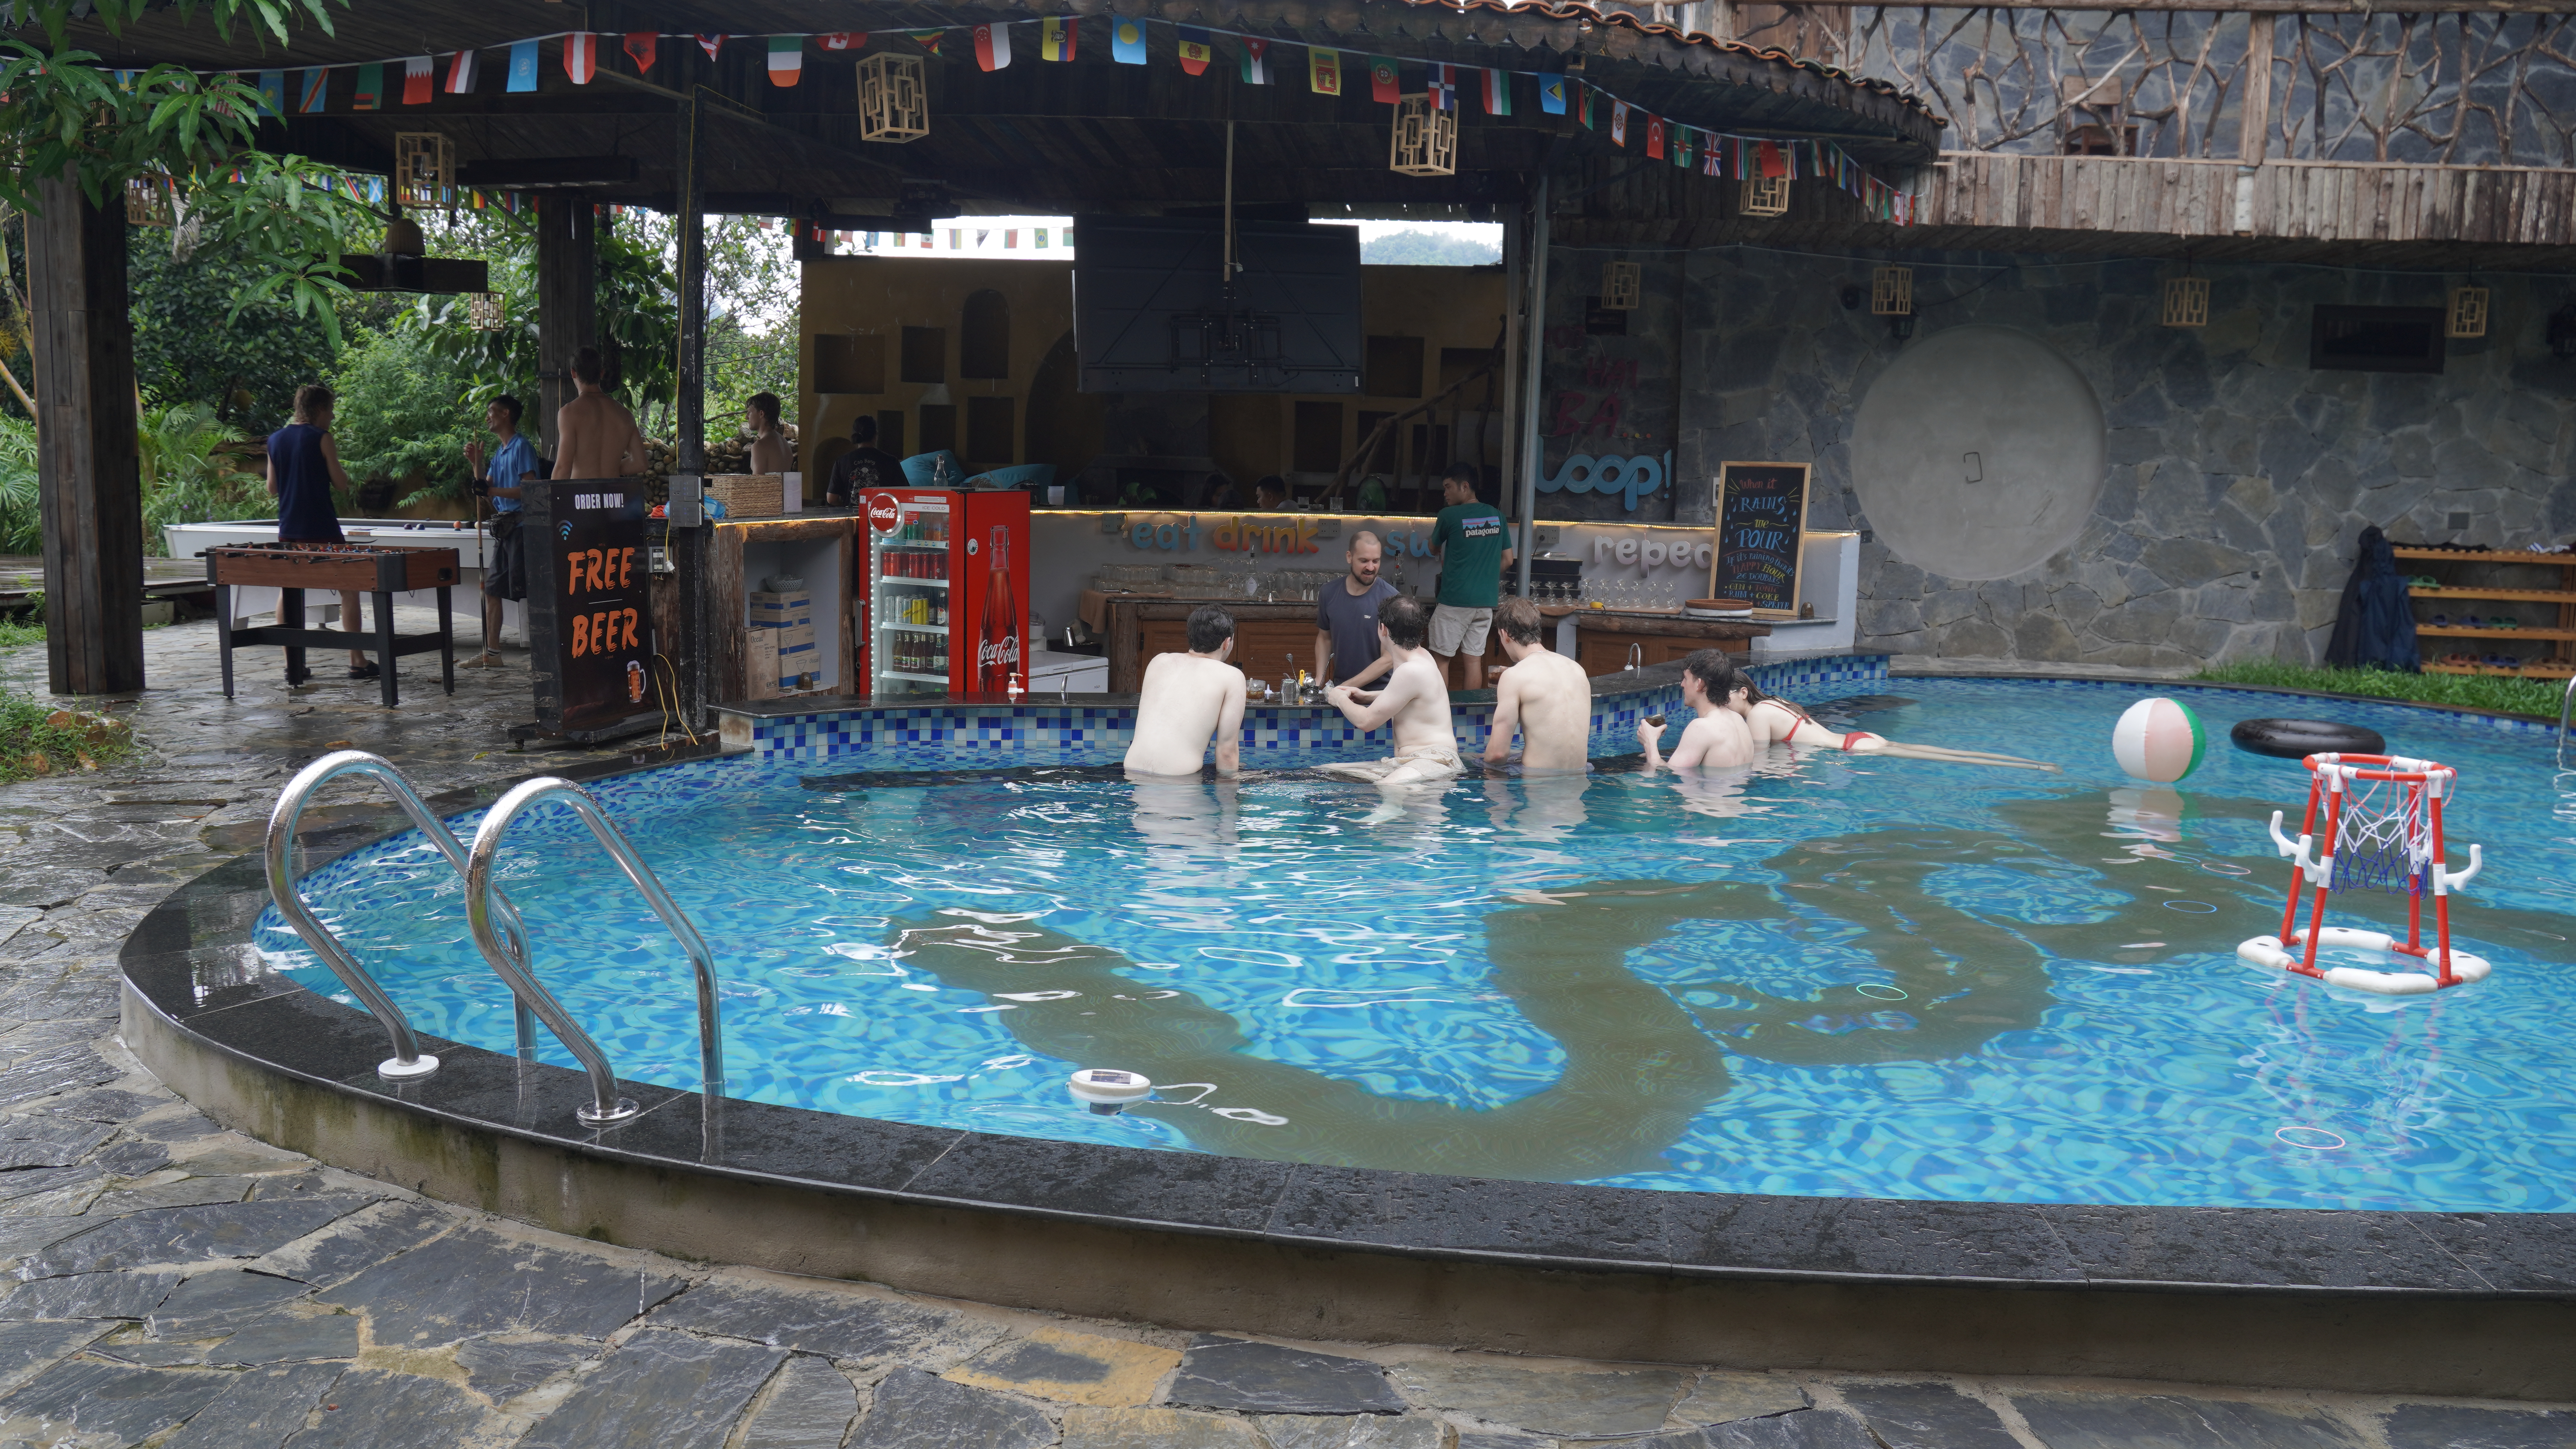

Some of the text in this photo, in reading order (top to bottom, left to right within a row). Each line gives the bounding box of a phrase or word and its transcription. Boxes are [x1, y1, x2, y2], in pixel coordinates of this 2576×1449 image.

[1544, 326, 1586, 349] OT
[1587, 357, 1638, 390] HAI
[1553, 392, 1621, 438] BA
[1740, 478, 1778, 489] When it
[575, 493, 624, 509] ORDER NOW!
[1739, 496, 1787, 515] RAINS
[870, 507, 896, 519] Coca-Cola
[1465, 526, 1500, 538] patagonia
[1755, 519, 1769, 528] we
[1131, 515, 1201, 551] eat
[1213, 515, 1319, 554] drink
[1594, 535, 1713, 578] repea
[1735, 528, 1787, 553] POUR
[1749, 552, 1775, 564] raining
[568, 547, 635, 595] FREE
[1732, 561, 1786, 584] HAPPY HOUR
[1749, 573, 1780, 584] DOUBLES
[1755, 584, 1779, 593] TONIC
[1756, 592, 1780, 601] COKE
[1760, 600, 1789, 610] SPRITE
[571, 608, 638, 659] BEER
[978, 636, 1019, 667] Coca-Cola
